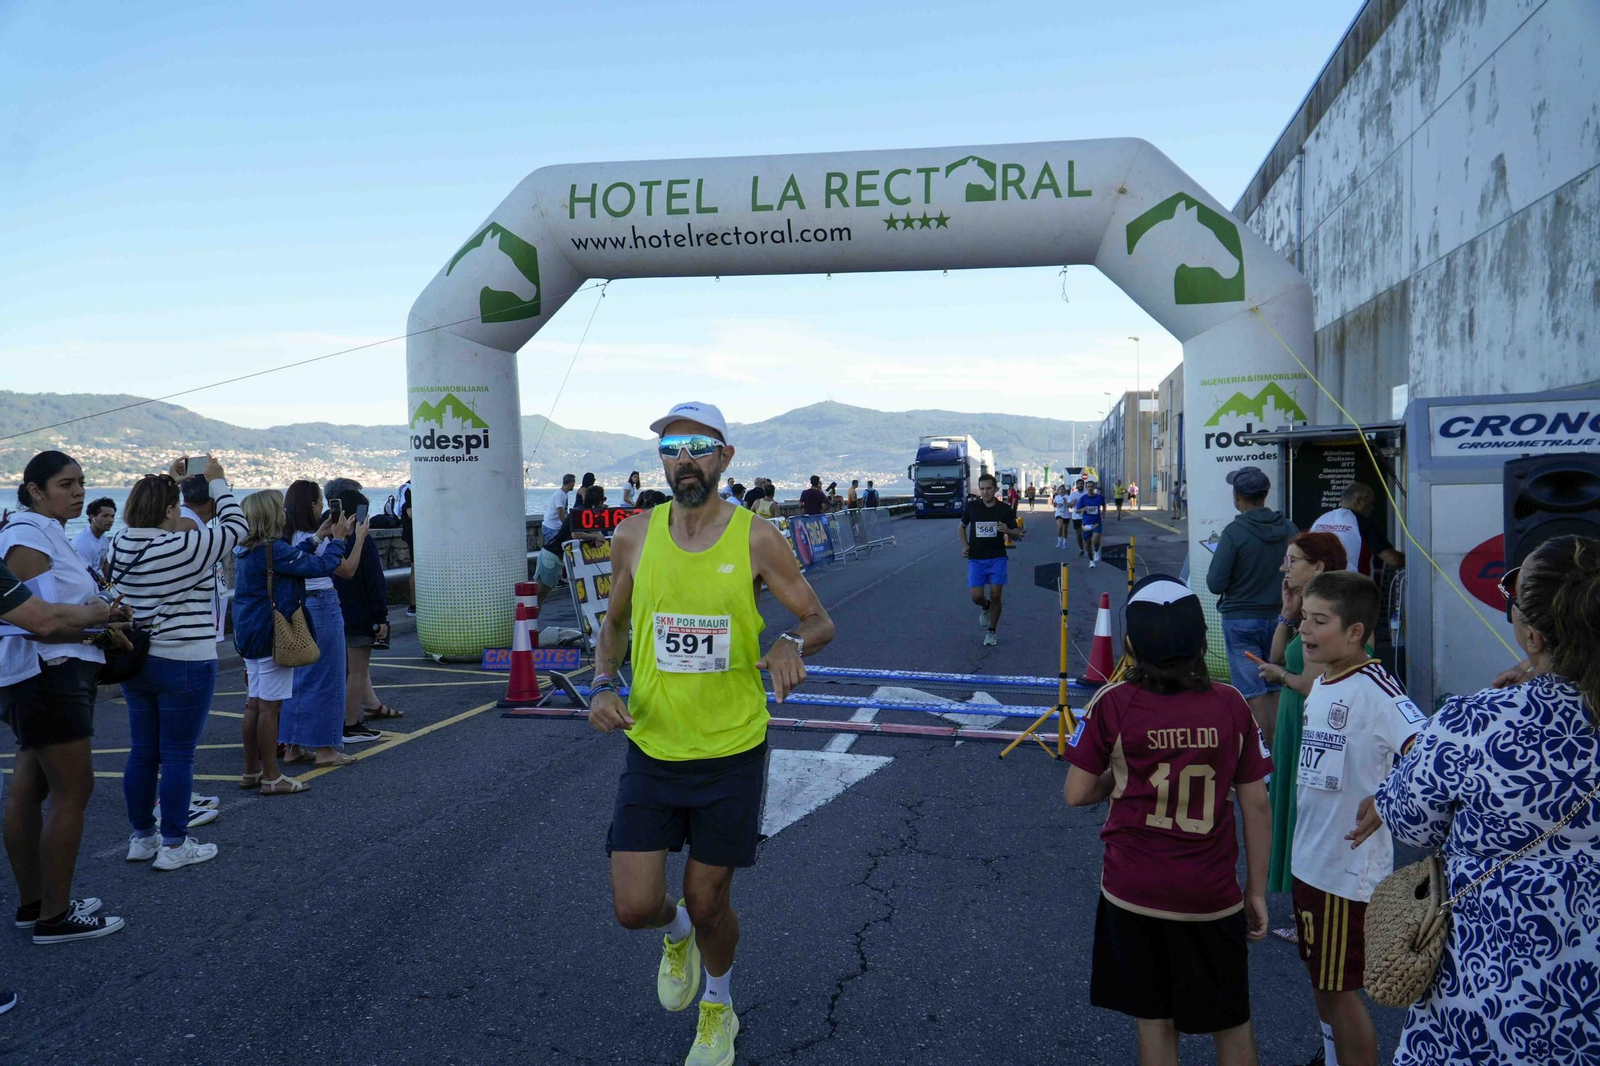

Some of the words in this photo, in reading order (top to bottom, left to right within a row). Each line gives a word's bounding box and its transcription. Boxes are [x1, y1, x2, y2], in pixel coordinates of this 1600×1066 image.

[569, 178, 718, 220] HOTEL
[751, 173, 806, 212] LA
[571, 218, 852, 252] www.hotelrectoral.com
[410, 428, 490, 455] rodespi
[1458, 438, 1596, 449] CRONOMETRAJE
[414, 454, 479, 463] www.rodespi.es
[656, 616, 674, 625] 5KM
[677, 618, 695, 627] POR
[665, 633, 714, 655] 591
[1147, 727, 1219, 749] SOTELDO
[1315, 730, 1347, 745] INFANTIS
[1300, 746, 1326, 769] 207
[1145, 762, 1216, 835] 10
